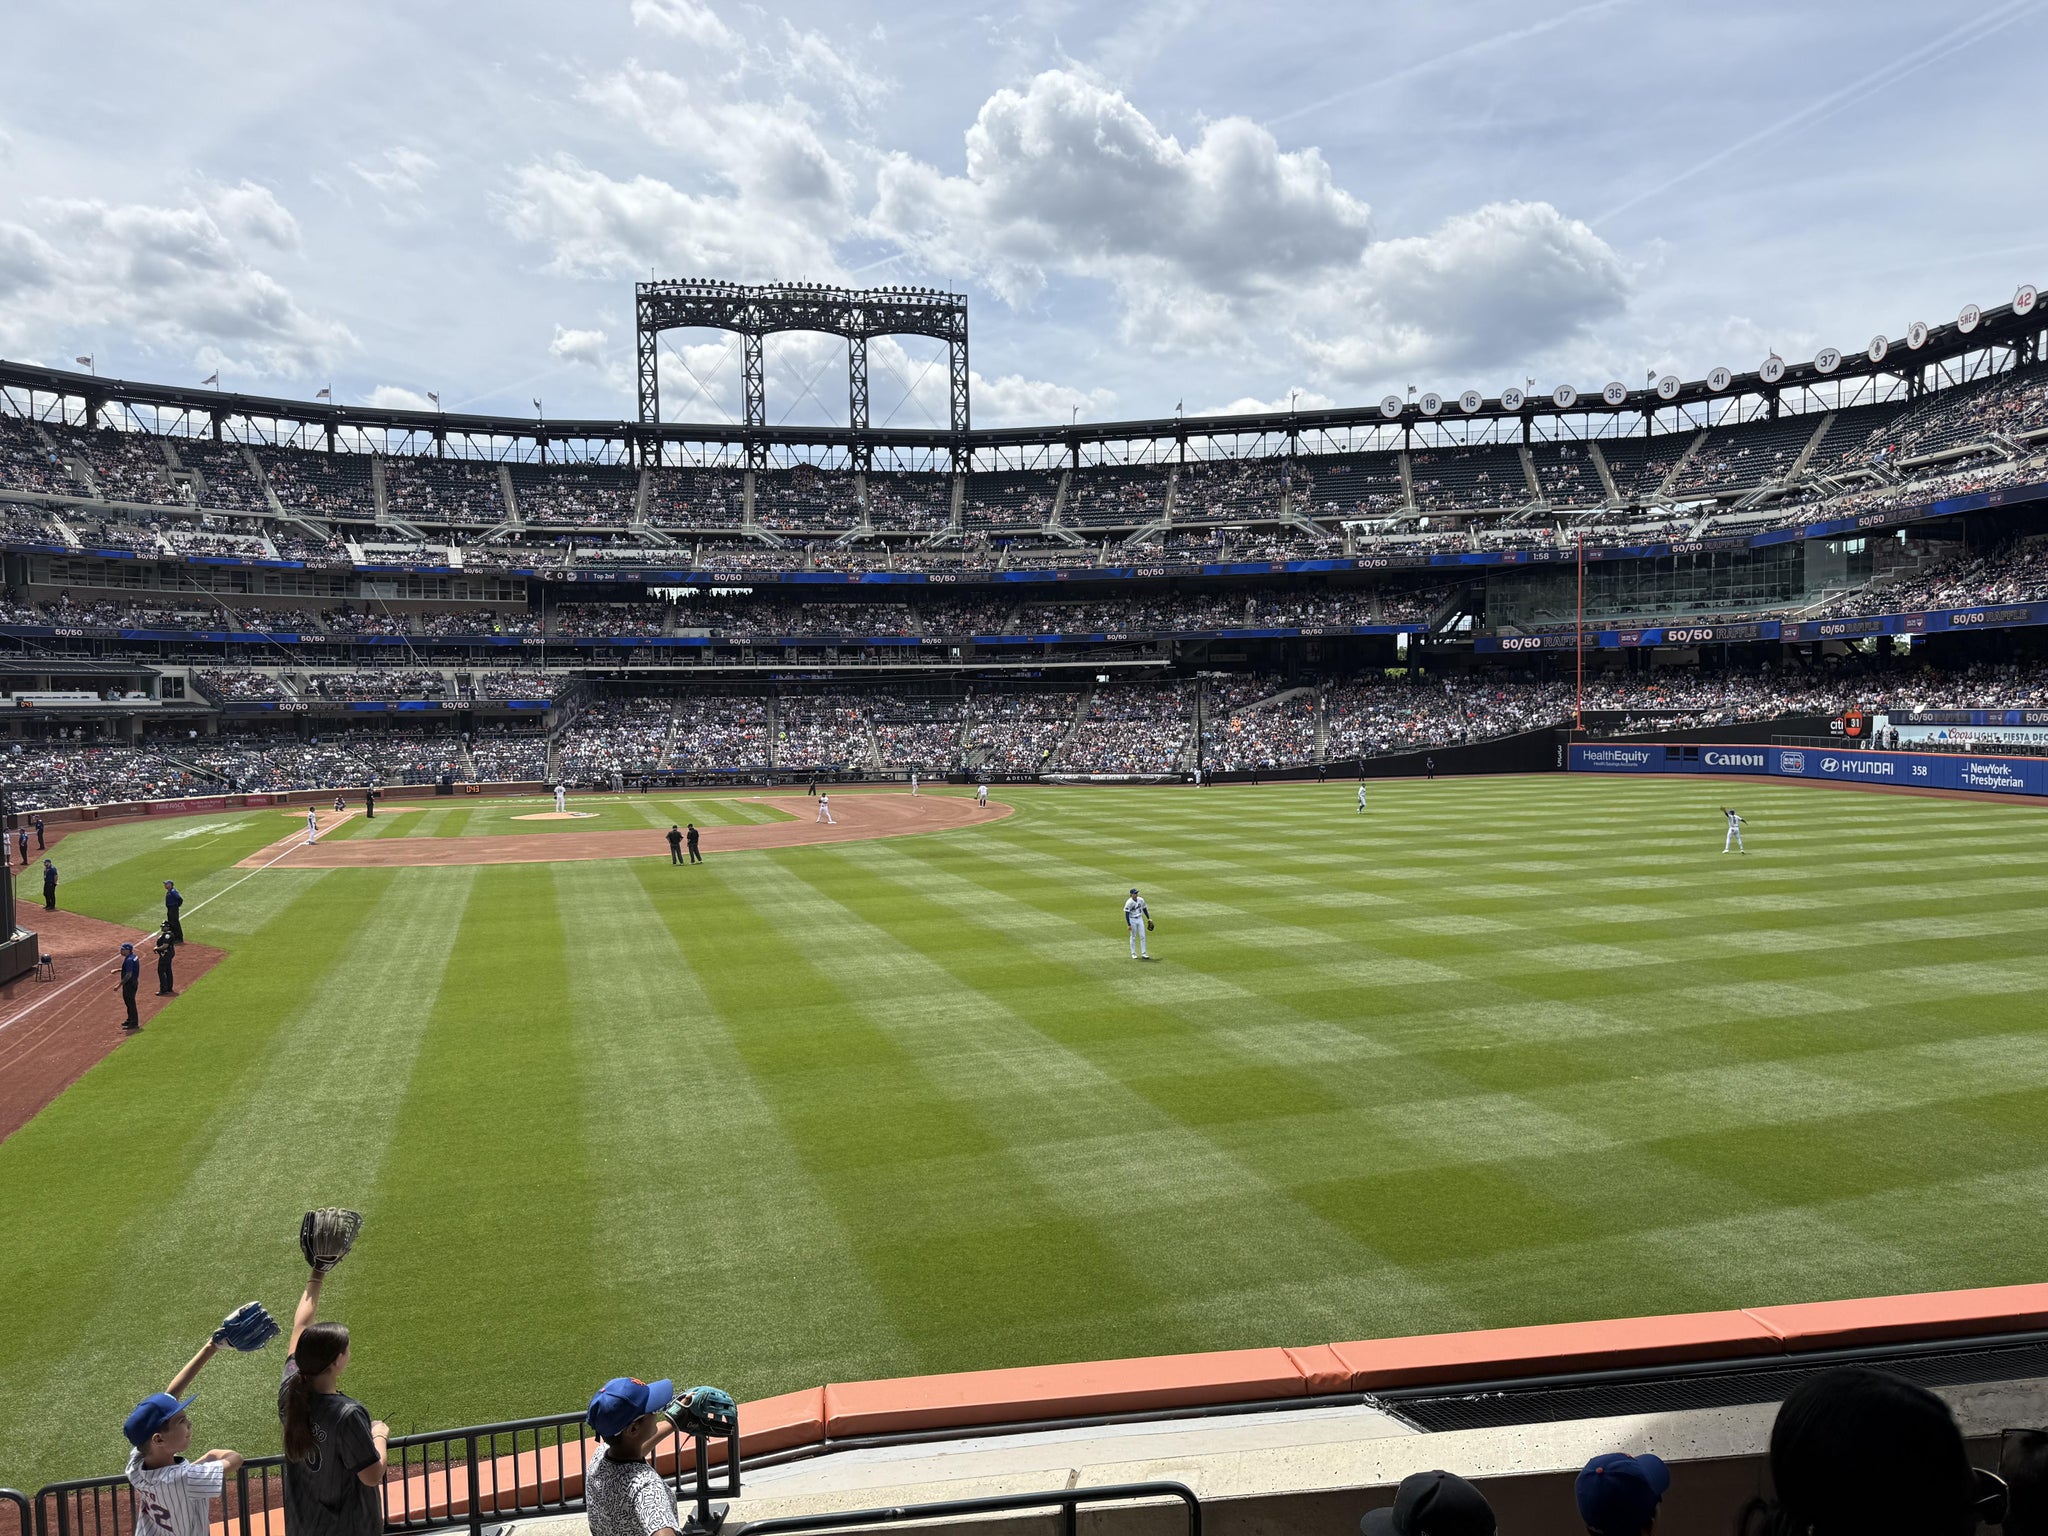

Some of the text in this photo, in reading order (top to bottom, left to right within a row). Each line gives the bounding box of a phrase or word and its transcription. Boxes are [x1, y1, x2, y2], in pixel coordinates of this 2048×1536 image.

[2016, 292, 2031, 308] 42
[1960, 312, 1978, 326] SHEA
[1820, 354, 1836, 366] 37
[1766, 364, 1778, 376] 14
[1713, 373, 1724, 384] 41
[1664, 382, 1674, 392] 31
[1559, 392, 1570, 402] 17
[1608, 388, 1622, 398] 36
[1466, 397, 1476, 407] 16
[1506, 394, 1519, 404] 24
[1388, 402, 1394, 412] 5
[1426, 400, 1436, 410] 18
[1858, 514, 1884, 526] 50/50
[1672, 543, 1702, 553] 50/50
[1533, 552, 1549, 560] 1:58
[1359, 560, 1388, 568] 50/50
[1138, 568, 1164, 577] 50/50
[714, 574, 742, 582] 50/50
[930, 575, 956, 583] 50/50
[1953, 612, 1984, 626] 50/50
[55, 628, 83, 637] 50/50
[1668, 626, 1757, 643] 50/50 RAFFLE
[1820, 624, 1845, 636] 50/50
[1502, 637, 1540, 650] 50/50
[279, 703, 308, 712] 50/50
[442, 702, 470, 710] 50/50
[1908, 713, 1934, 722] 50/50
[1830, 718, 1844, 730] citi
[1850, 718, 1860, 728] 31
[1948, 728, 1974, 740] Coors
[2004, 733, 2030, 741] FIESTA
[1583, 750, 1650, 764] HealthEquity
[1704, 752, 1764, 767] Canon
[1842, 760, 1894, 776] HYUNDAI
[1911, 766, 1928, 776] 358
[1970, 762, 2012, 776] NewYork-
[1970, 774, 2024, 790] Presbyterian
